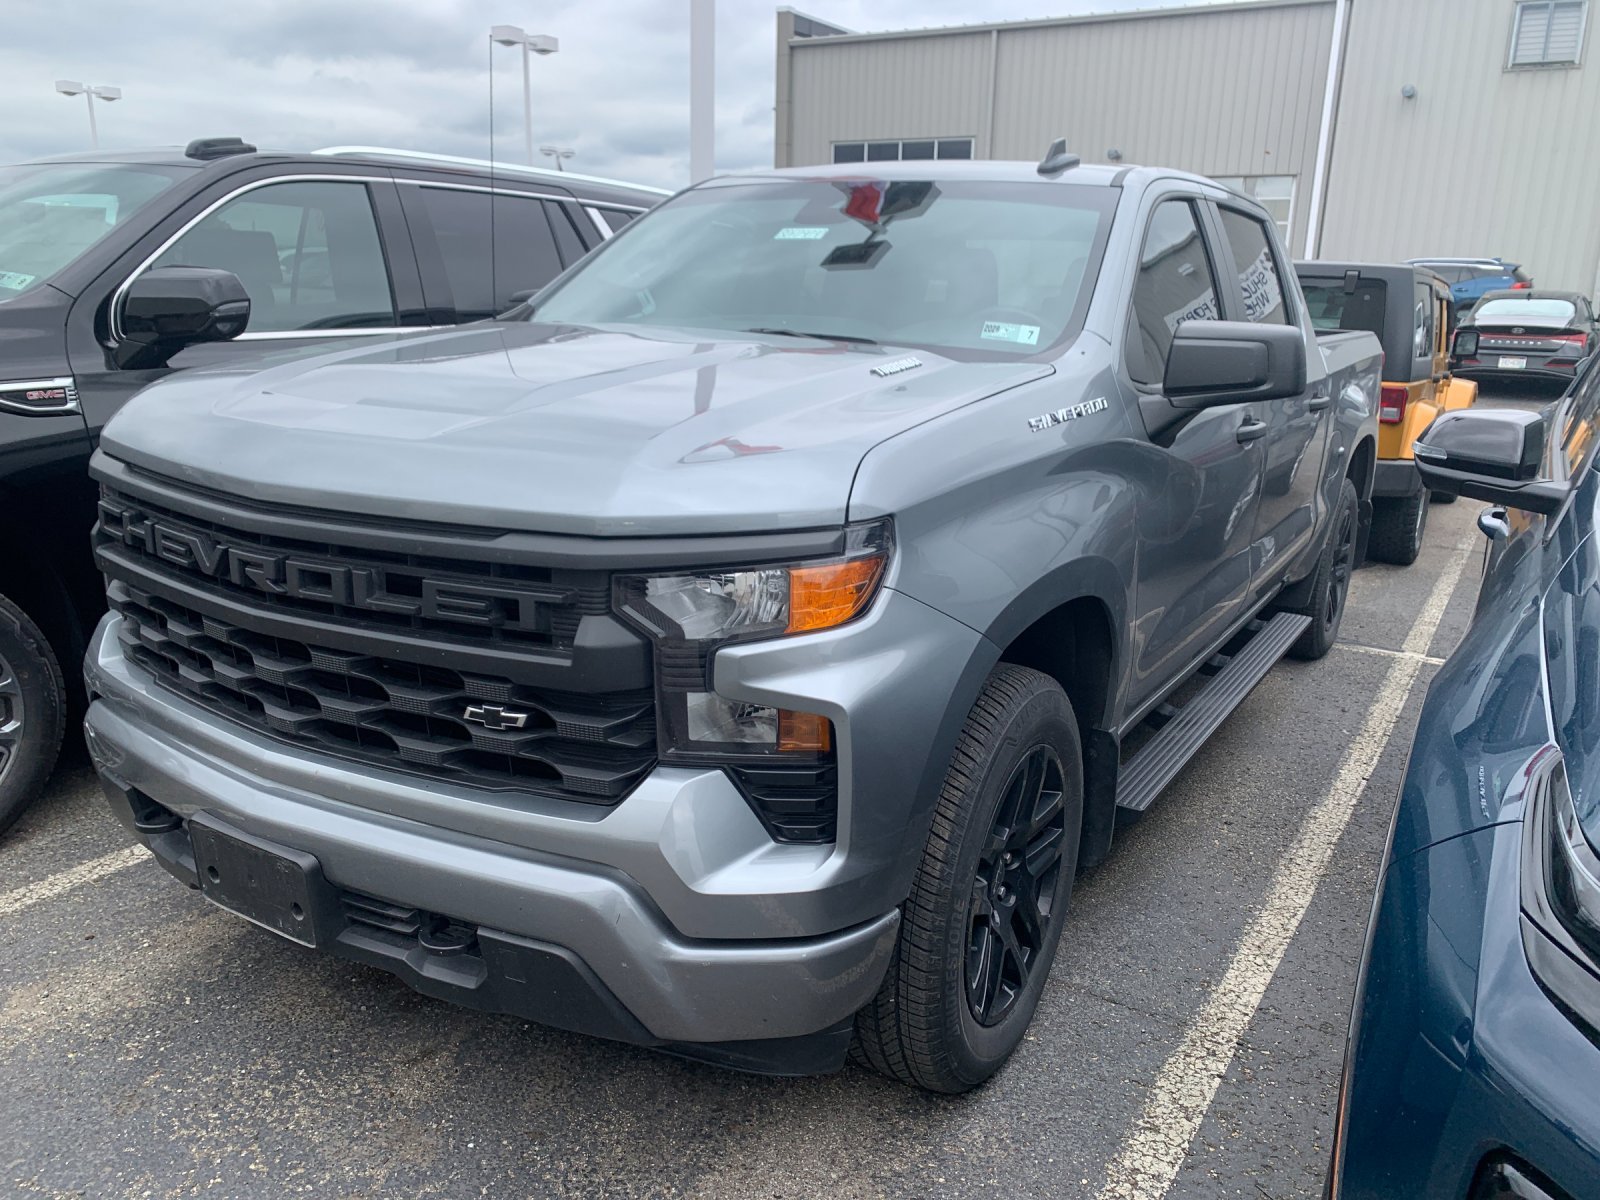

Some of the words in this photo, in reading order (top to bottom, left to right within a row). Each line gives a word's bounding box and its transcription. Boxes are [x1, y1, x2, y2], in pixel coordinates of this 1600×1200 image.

[1027, 330, 1034, 340] 7
[26, 388, 65, 400] GMC
[1028, 396, 1109, 433] SILVERADO
[97, 498, 577, 634] CHEVROLET
